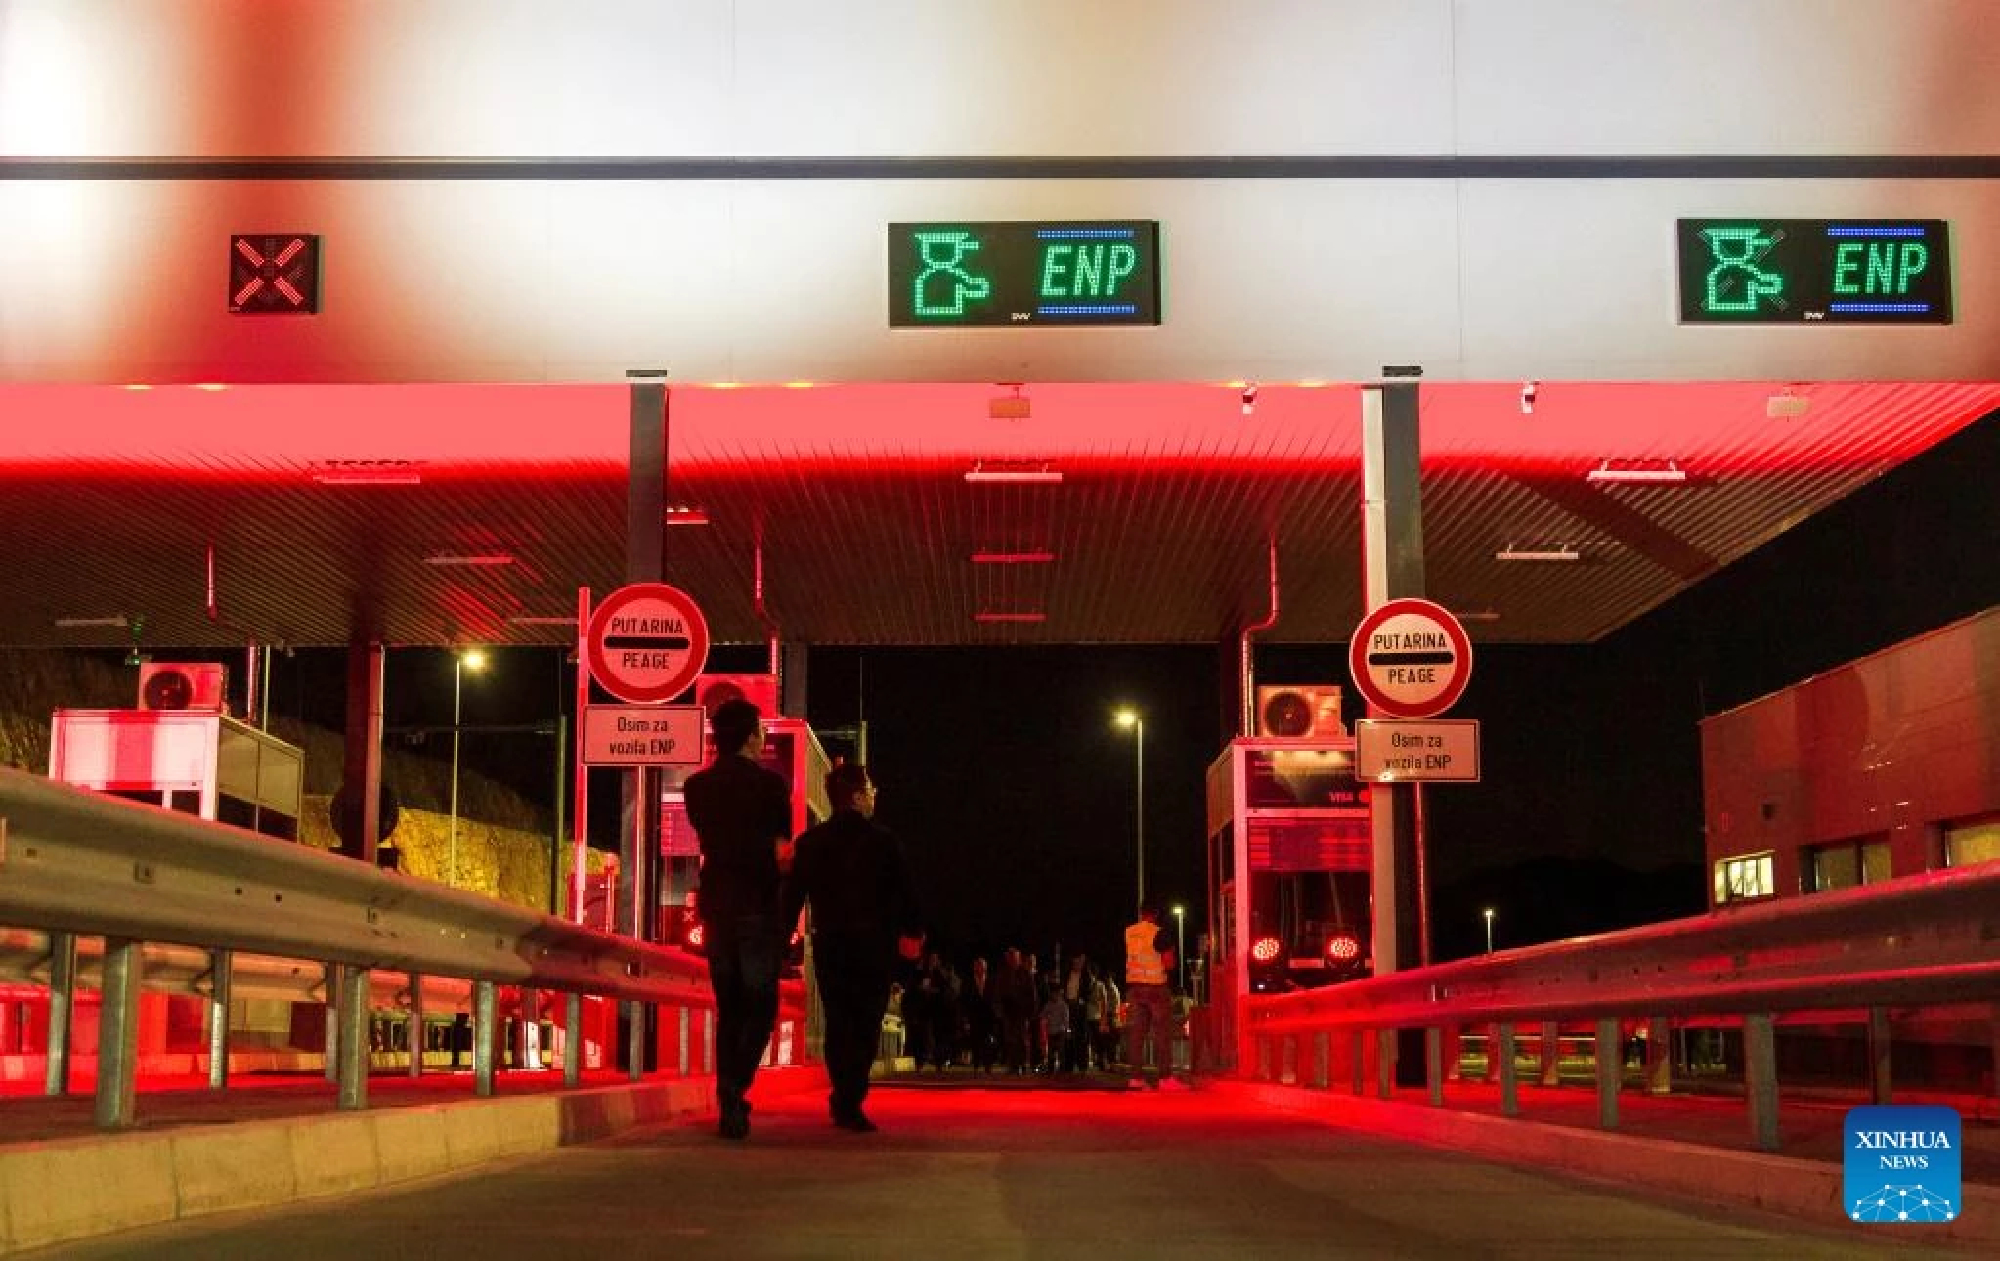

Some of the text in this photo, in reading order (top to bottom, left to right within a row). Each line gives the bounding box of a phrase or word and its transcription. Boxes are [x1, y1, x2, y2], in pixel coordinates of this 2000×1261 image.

[1040, 244, 1137, 296] ENP
[1833, 243, 1929, 294] ENP
[611, 617, 683, 634] PUTARINA
[1373, 632, 1448, 650] PUTARINA
[623, 652, 670, 670] PEAGE
[1388, 668, 1436, 685] PEAGE
[617, 716, 668, 732] Osim za
[609, 738, 675, 755] vozila ENP
[1391, 732, 1443, 748] Osim za
[1384, 754, 1452, 769] vozila ENP
